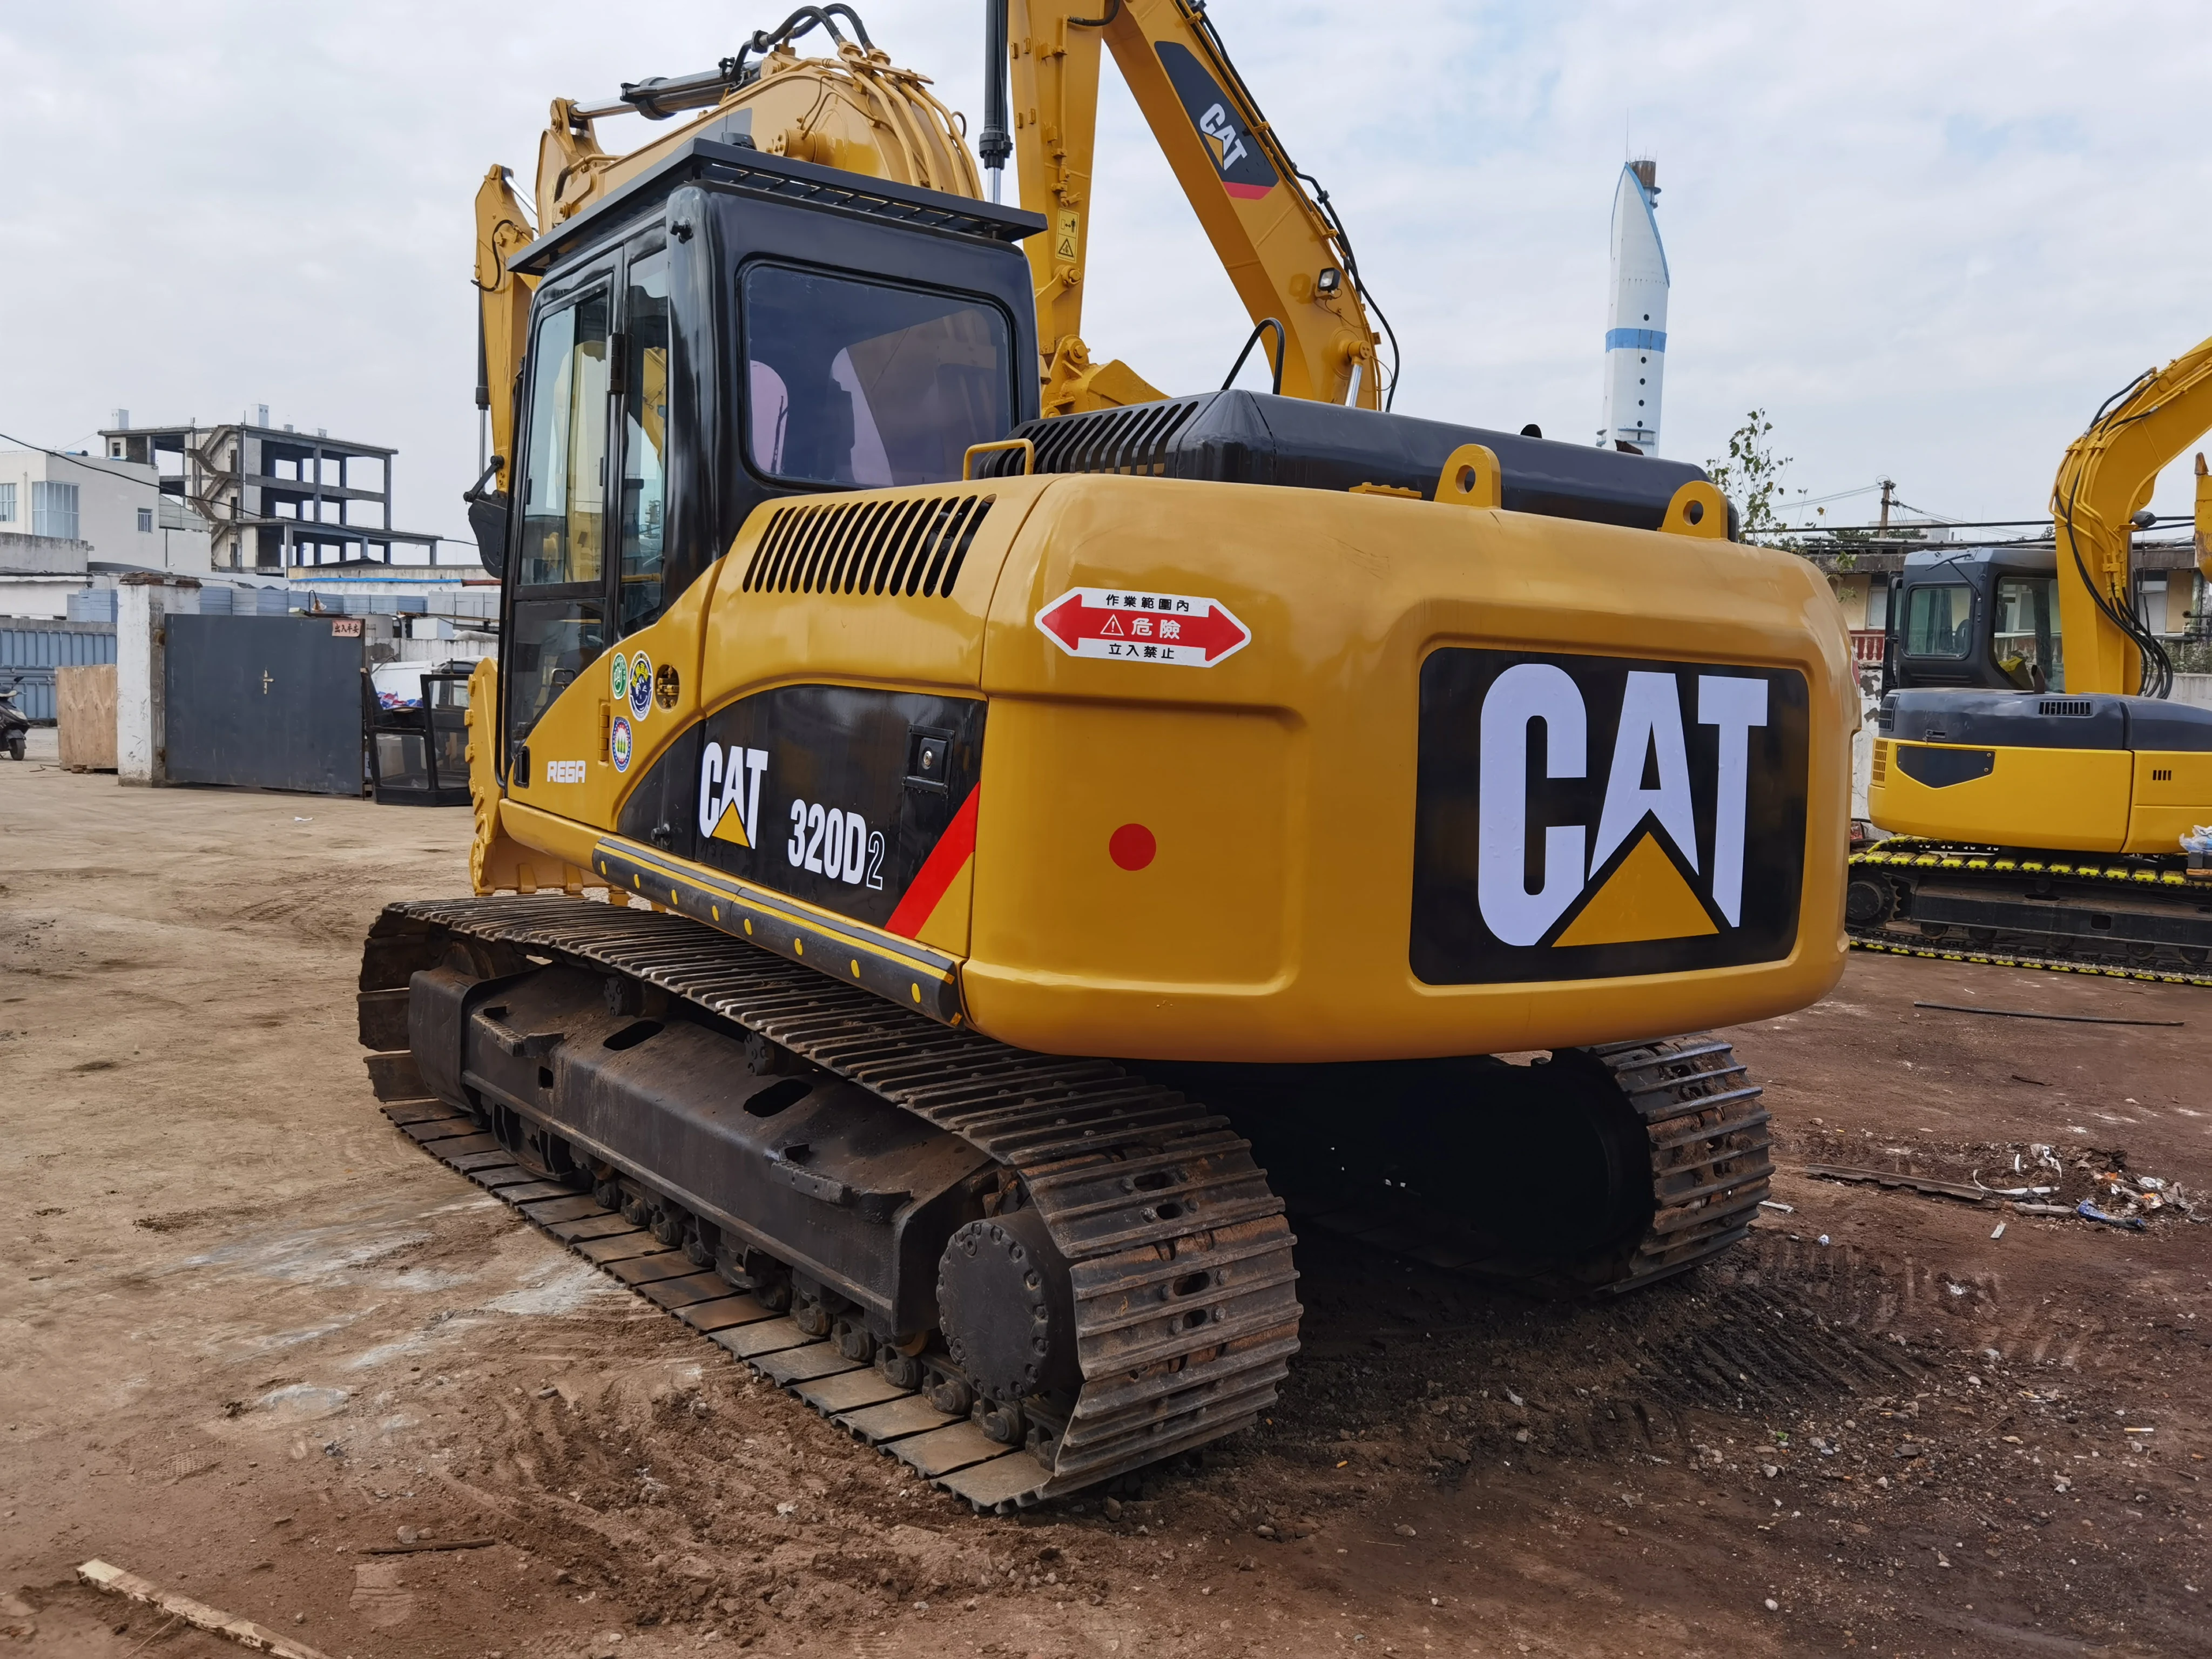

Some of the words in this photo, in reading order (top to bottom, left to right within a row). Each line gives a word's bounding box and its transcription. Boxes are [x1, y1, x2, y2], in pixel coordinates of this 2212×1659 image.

[1200, 103, 1247, 171] CAT
[334, 623, 359, 634] 出入平安
[1131, 617, 1181, 639] 危險
[1108, 643, 1175, 659] 立入禁止
[699, 741, 768, 849] CAT
[1478, 663, 1769, 947] CAT
